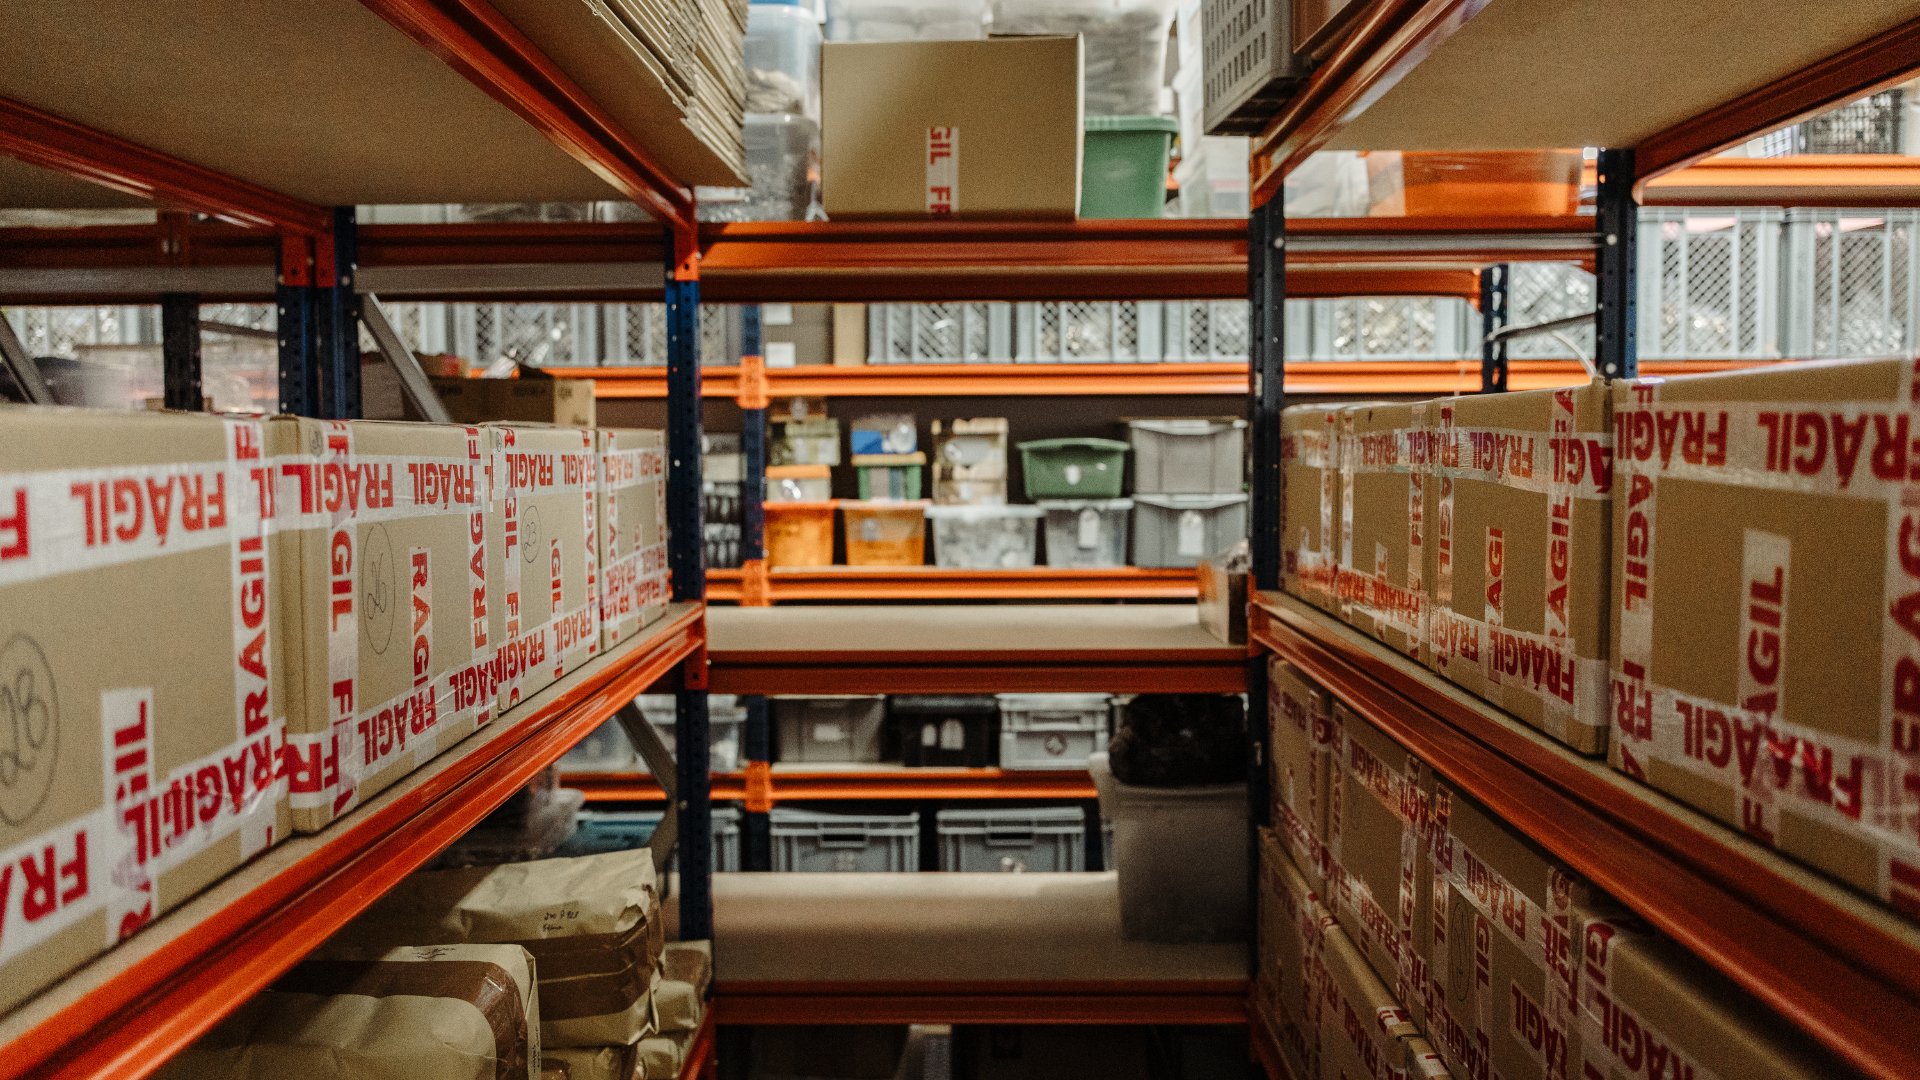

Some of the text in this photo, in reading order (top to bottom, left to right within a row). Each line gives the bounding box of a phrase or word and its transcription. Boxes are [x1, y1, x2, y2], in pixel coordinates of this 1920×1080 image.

[1469, 431, 1534, 480] FRÁGIL
[1614, 410, 1729, 471] FRÁGIL
[282, 463, 394, 518] FRÁGIL
[408, 462, 475, 510] FRÁGIL
[506, 453, 553, 492] FRÁGIL
[70, 471, 227, 547] FRÁGIL
[238, 536, 269, 737] RÁGIL
[497, 629, 546, 684] FRÁGIL
[552, 607, 593, 655] FRÁGIL
[357, 685, 437, 766] FRÁGIL
[1463, 849, 1527, 942] FRÁGIL
